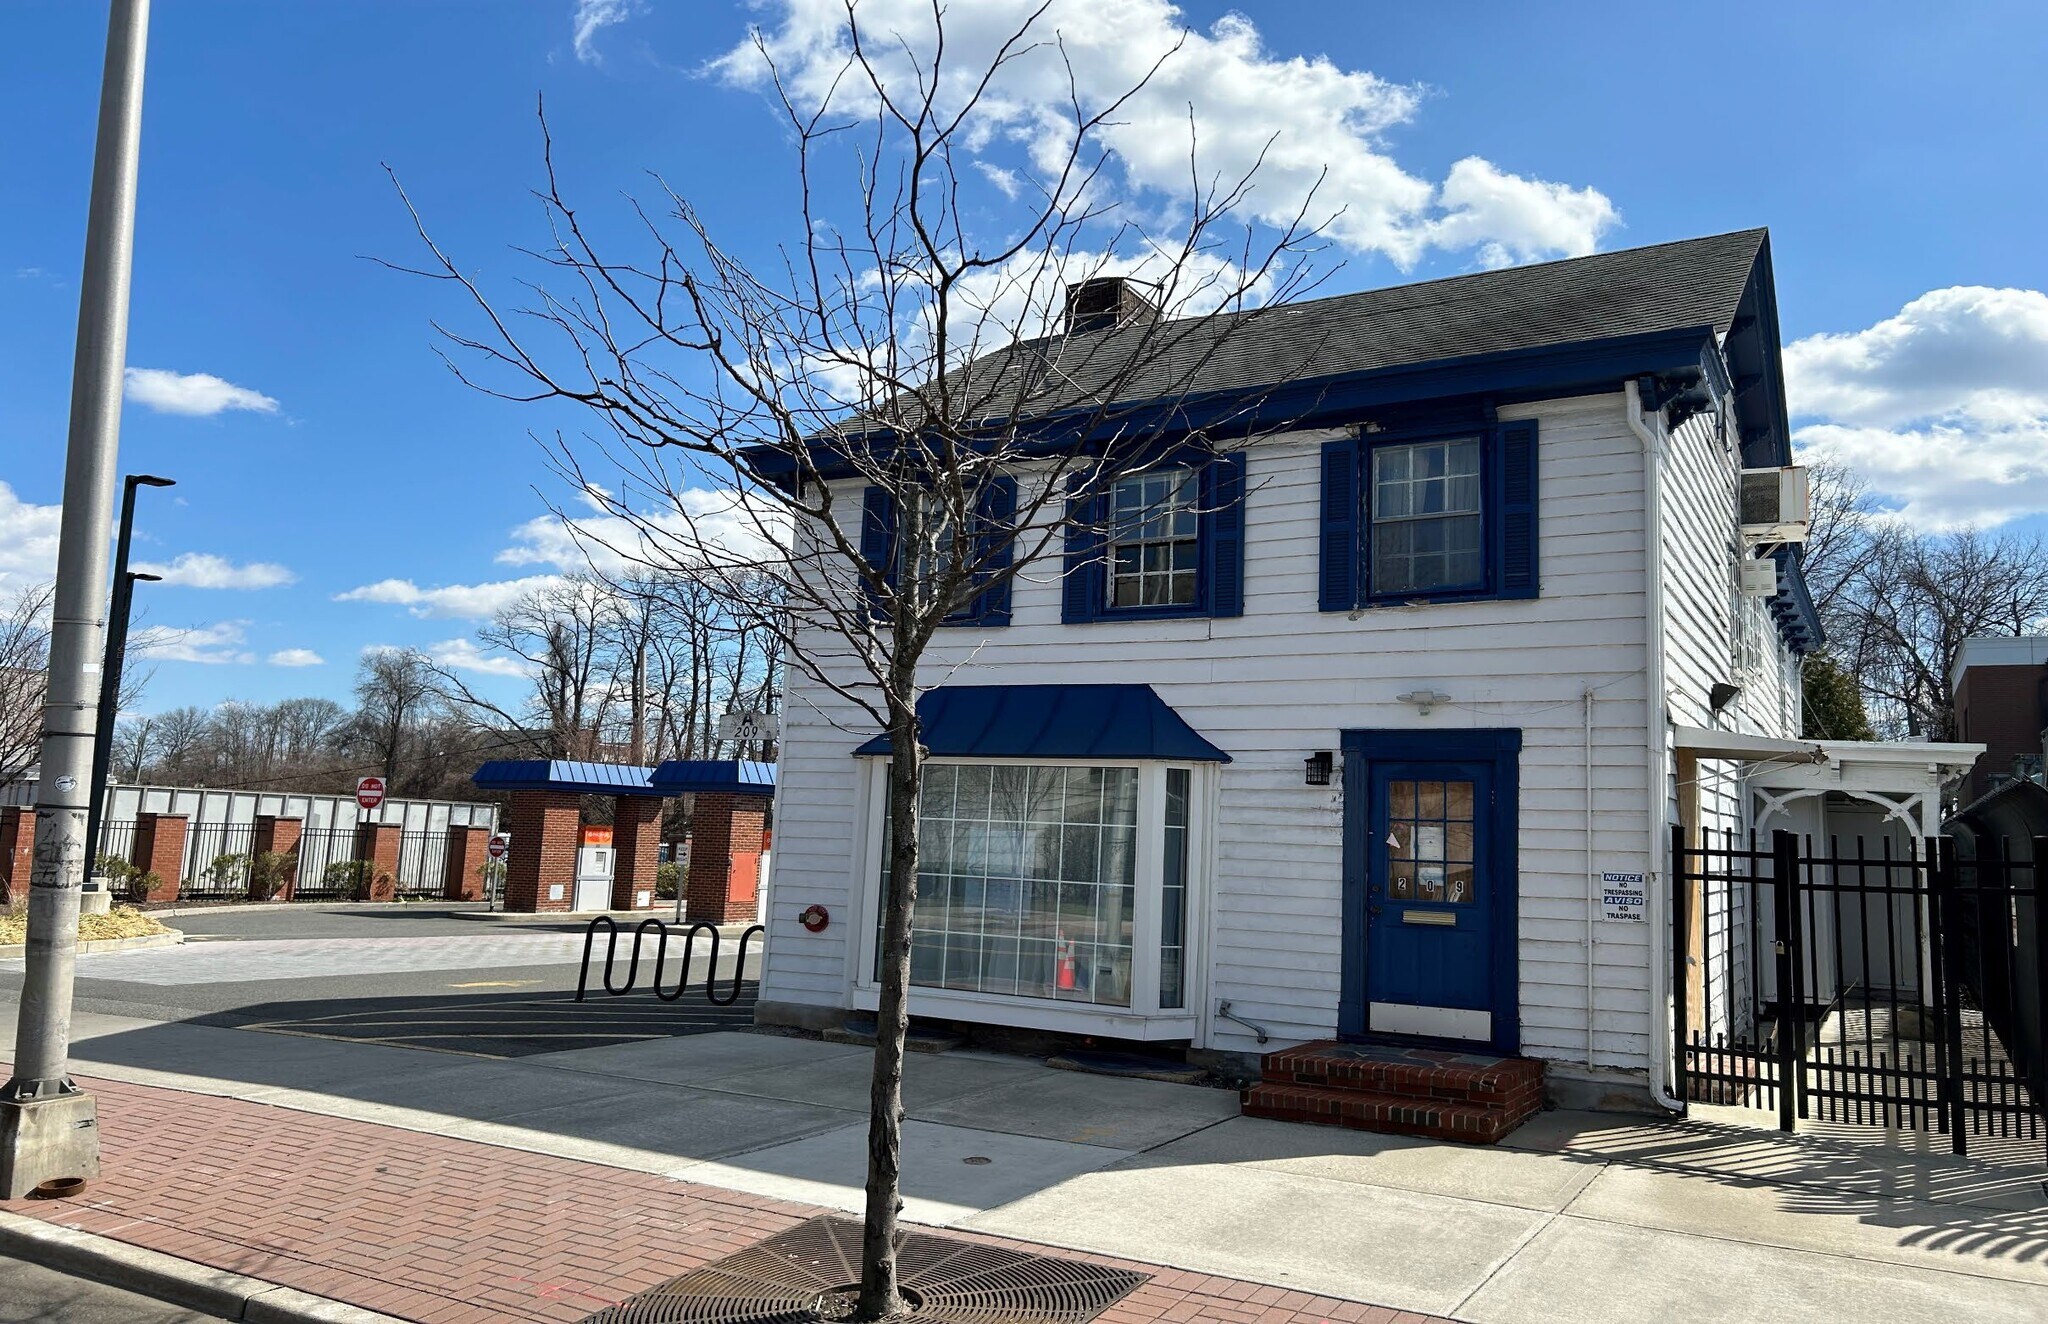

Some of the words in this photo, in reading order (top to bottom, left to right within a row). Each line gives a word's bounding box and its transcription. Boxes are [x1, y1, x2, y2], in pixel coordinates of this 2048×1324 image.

[734, 726, 758, 738] 209
[1605, 874, 1641, 882] NOTICE
[1606, 897, 1642, 905] AVISO
[1606, 912, 1641, 920] TRASPASE
